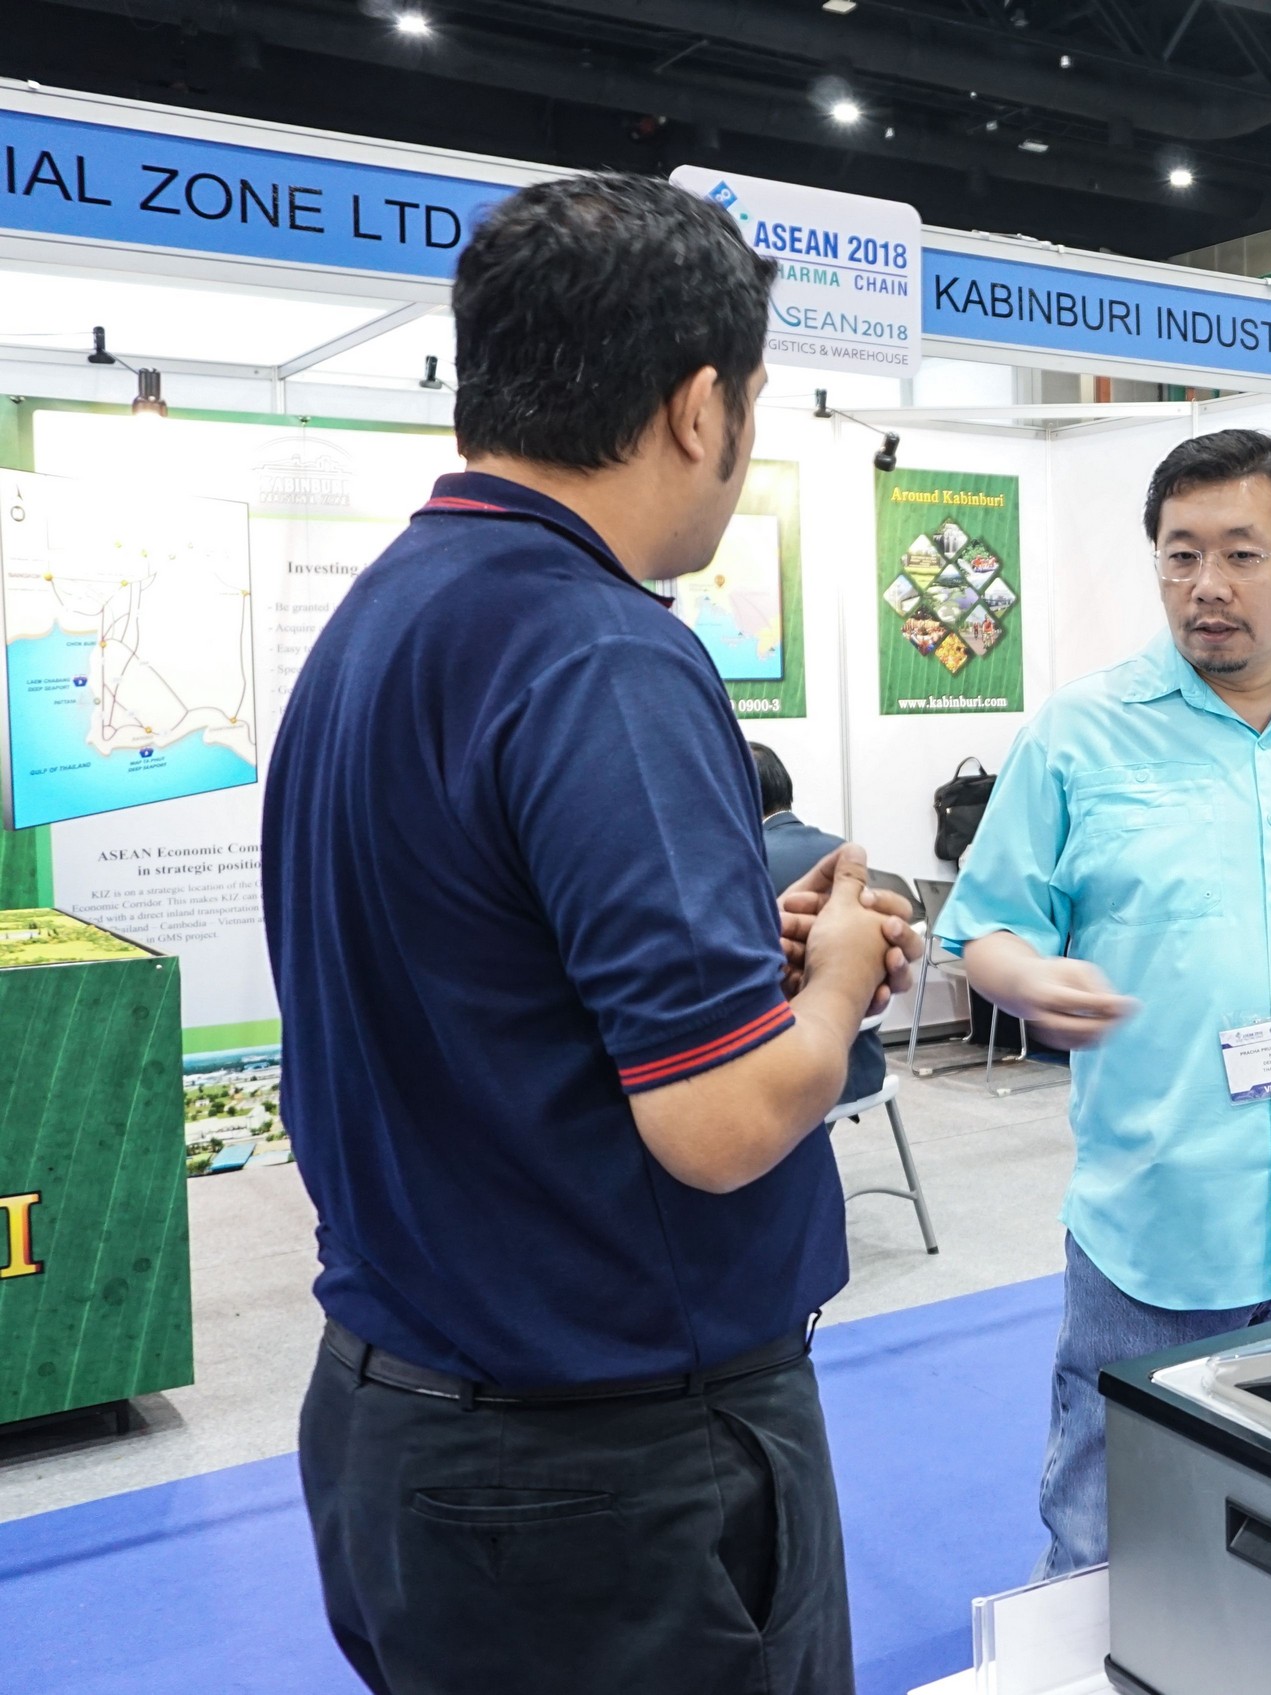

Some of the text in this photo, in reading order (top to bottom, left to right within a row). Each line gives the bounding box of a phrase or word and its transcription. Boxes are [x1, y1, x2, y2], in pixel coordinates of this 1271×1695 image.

[6, 145, 462, 250] IAL ZONE LTD
[753, 221, 908, 269] ASEAN 2018
[776, 263, 908, 296] HARMA CHAIN
[935, 274, 1141, 336] KABINBURI
[784, 305, 909, 341] SEAN2018
[768, 338, 909, 366] GISTICS & WAREHOUSE
[891, 487, 1005, 507] Around Kabinburi
[287, 560, 359, 577] Investing
[275, 602, 329, 614] Be granted
[275, 623, 316, 635] Acquire
[277, 643, 301, 655] Easy
[277, 664, 301, 676] Spec
[738, 698, 780, 711] 0900-3
[898, 695, 1008, 709] www.kabinburi.com
[98, 843, 259, 862] ASEAN Economic Com
[137, 858, 261, 876] in strategic positio
[91, 889, 111, 899] KIZ
[114, 889, 122, 897] is
[124, 889, 136, 897] on
[147, 885, 185, 896] strategic
[188, 883, 224, 893] location
[227, 880, 237, 890] of
[239, 880, 252, 889] the
[72, 903, 120, 913] Economic
[168, 897, 187, 906] This
[190, 895, 218, 905] makes
[242, 893, 257, 901] can
[106, 912, 127, 923] with
[137, 911, 163, 920] direct
[166, 908, 195, 918] inland
[197, 904, 259, 916] transportation
[160, 920, 207, 930] Cambodia
[218, 916, 255, 926] Vietnam
[146, 936, 155, 944] in
[158, 932, 183, 943] GMS
